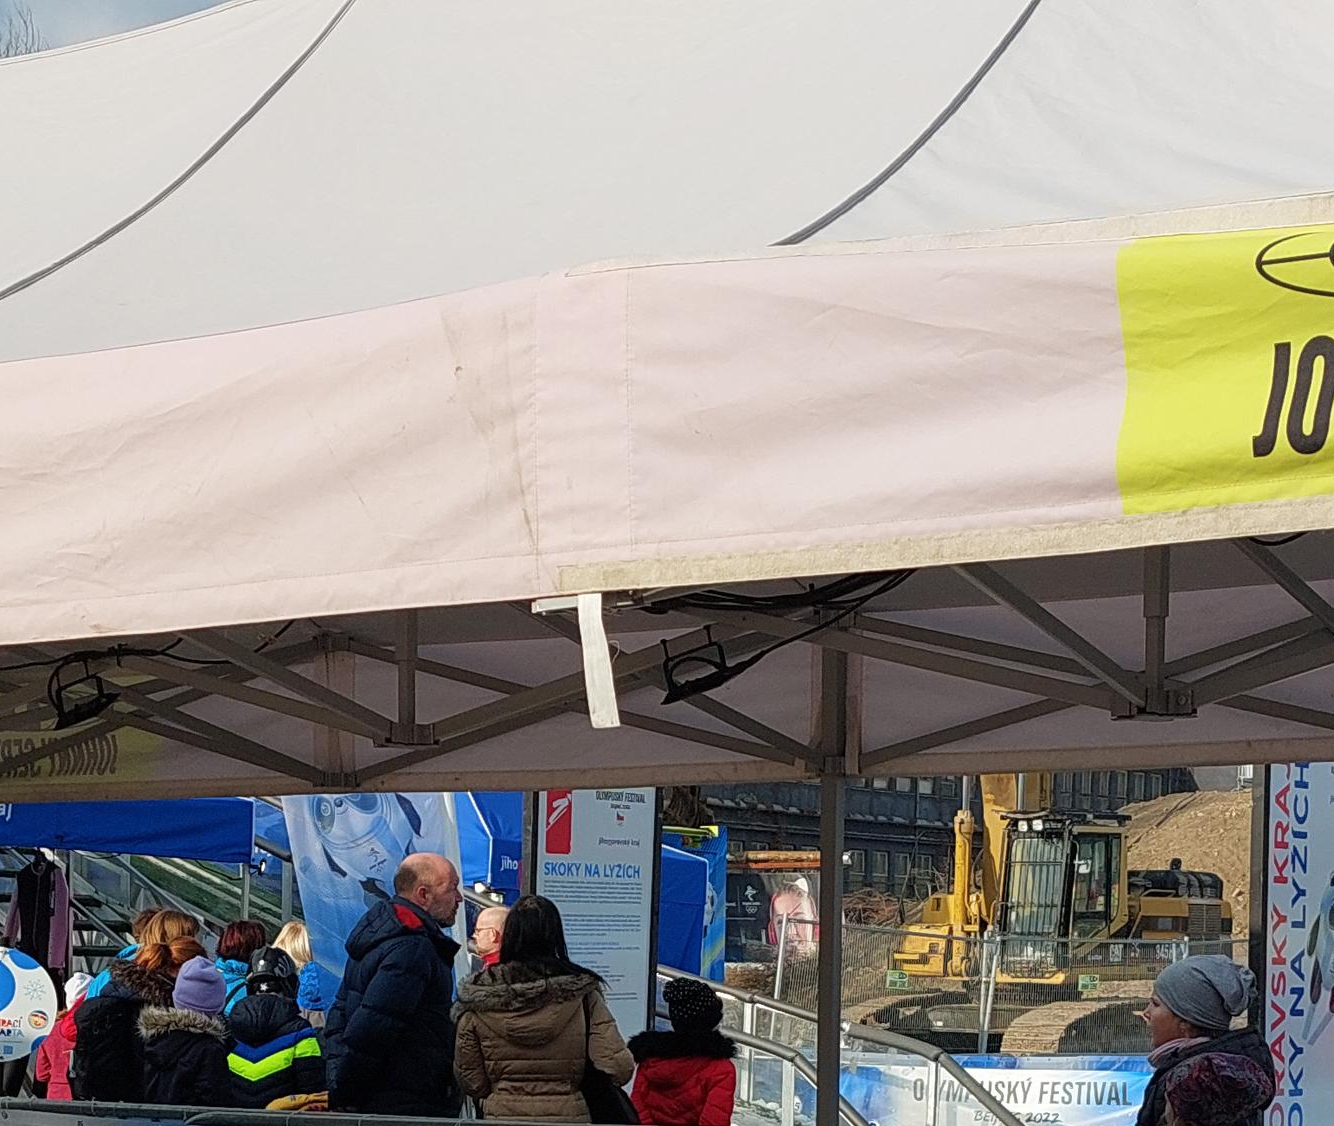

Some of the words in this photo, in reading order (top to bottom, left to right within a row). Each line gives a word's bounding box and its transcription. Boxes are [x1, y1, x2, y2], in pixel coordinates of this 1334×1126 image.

[544, 862, 581, 876] SKOKY
[585, 863, 600, 878] NA
[604, 863, 640, 878] LYŽÍCH
[1289, 948, 1306, 1017] NA
[1038, 1079, 1133, 1107] FESTIVAL
[1025, 1112, 1063, 1124] 2022
